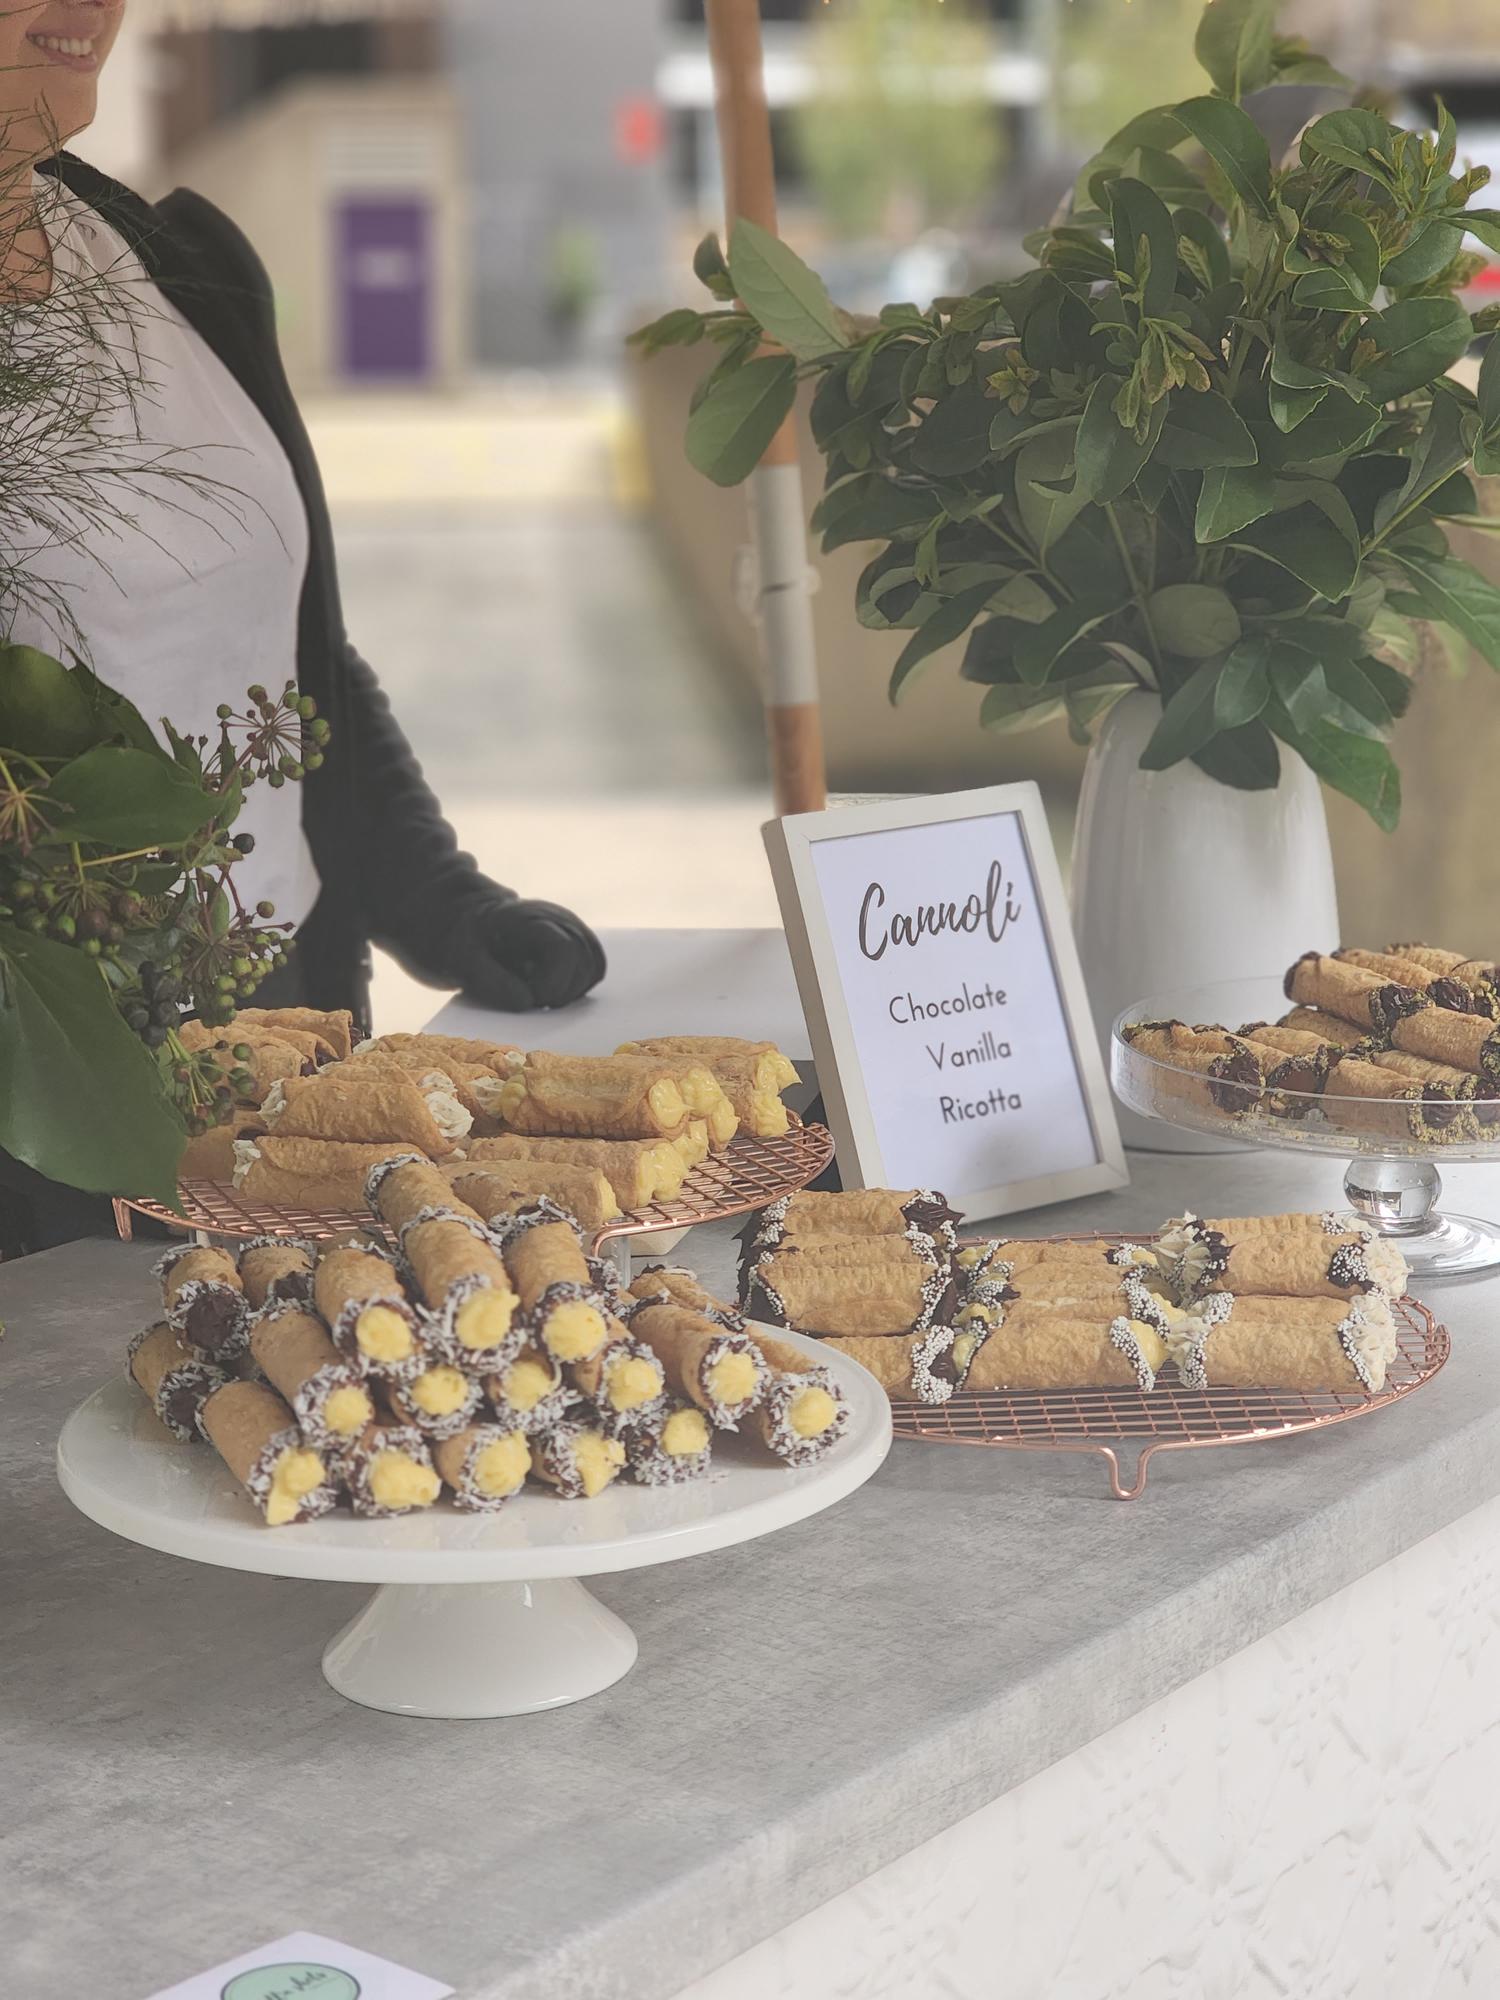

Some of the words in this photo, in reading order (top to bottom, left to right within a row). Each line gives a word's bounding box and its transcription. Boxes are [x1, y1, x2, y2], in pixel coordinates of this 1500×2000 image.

[858, 860, 1021, 961] Cannoli
[889, 982, 1007, 1024] Chocolate
[926, 1031, 1012, 1070] Vanilla
[940, 1088, 1022, 1124] Ricotta
